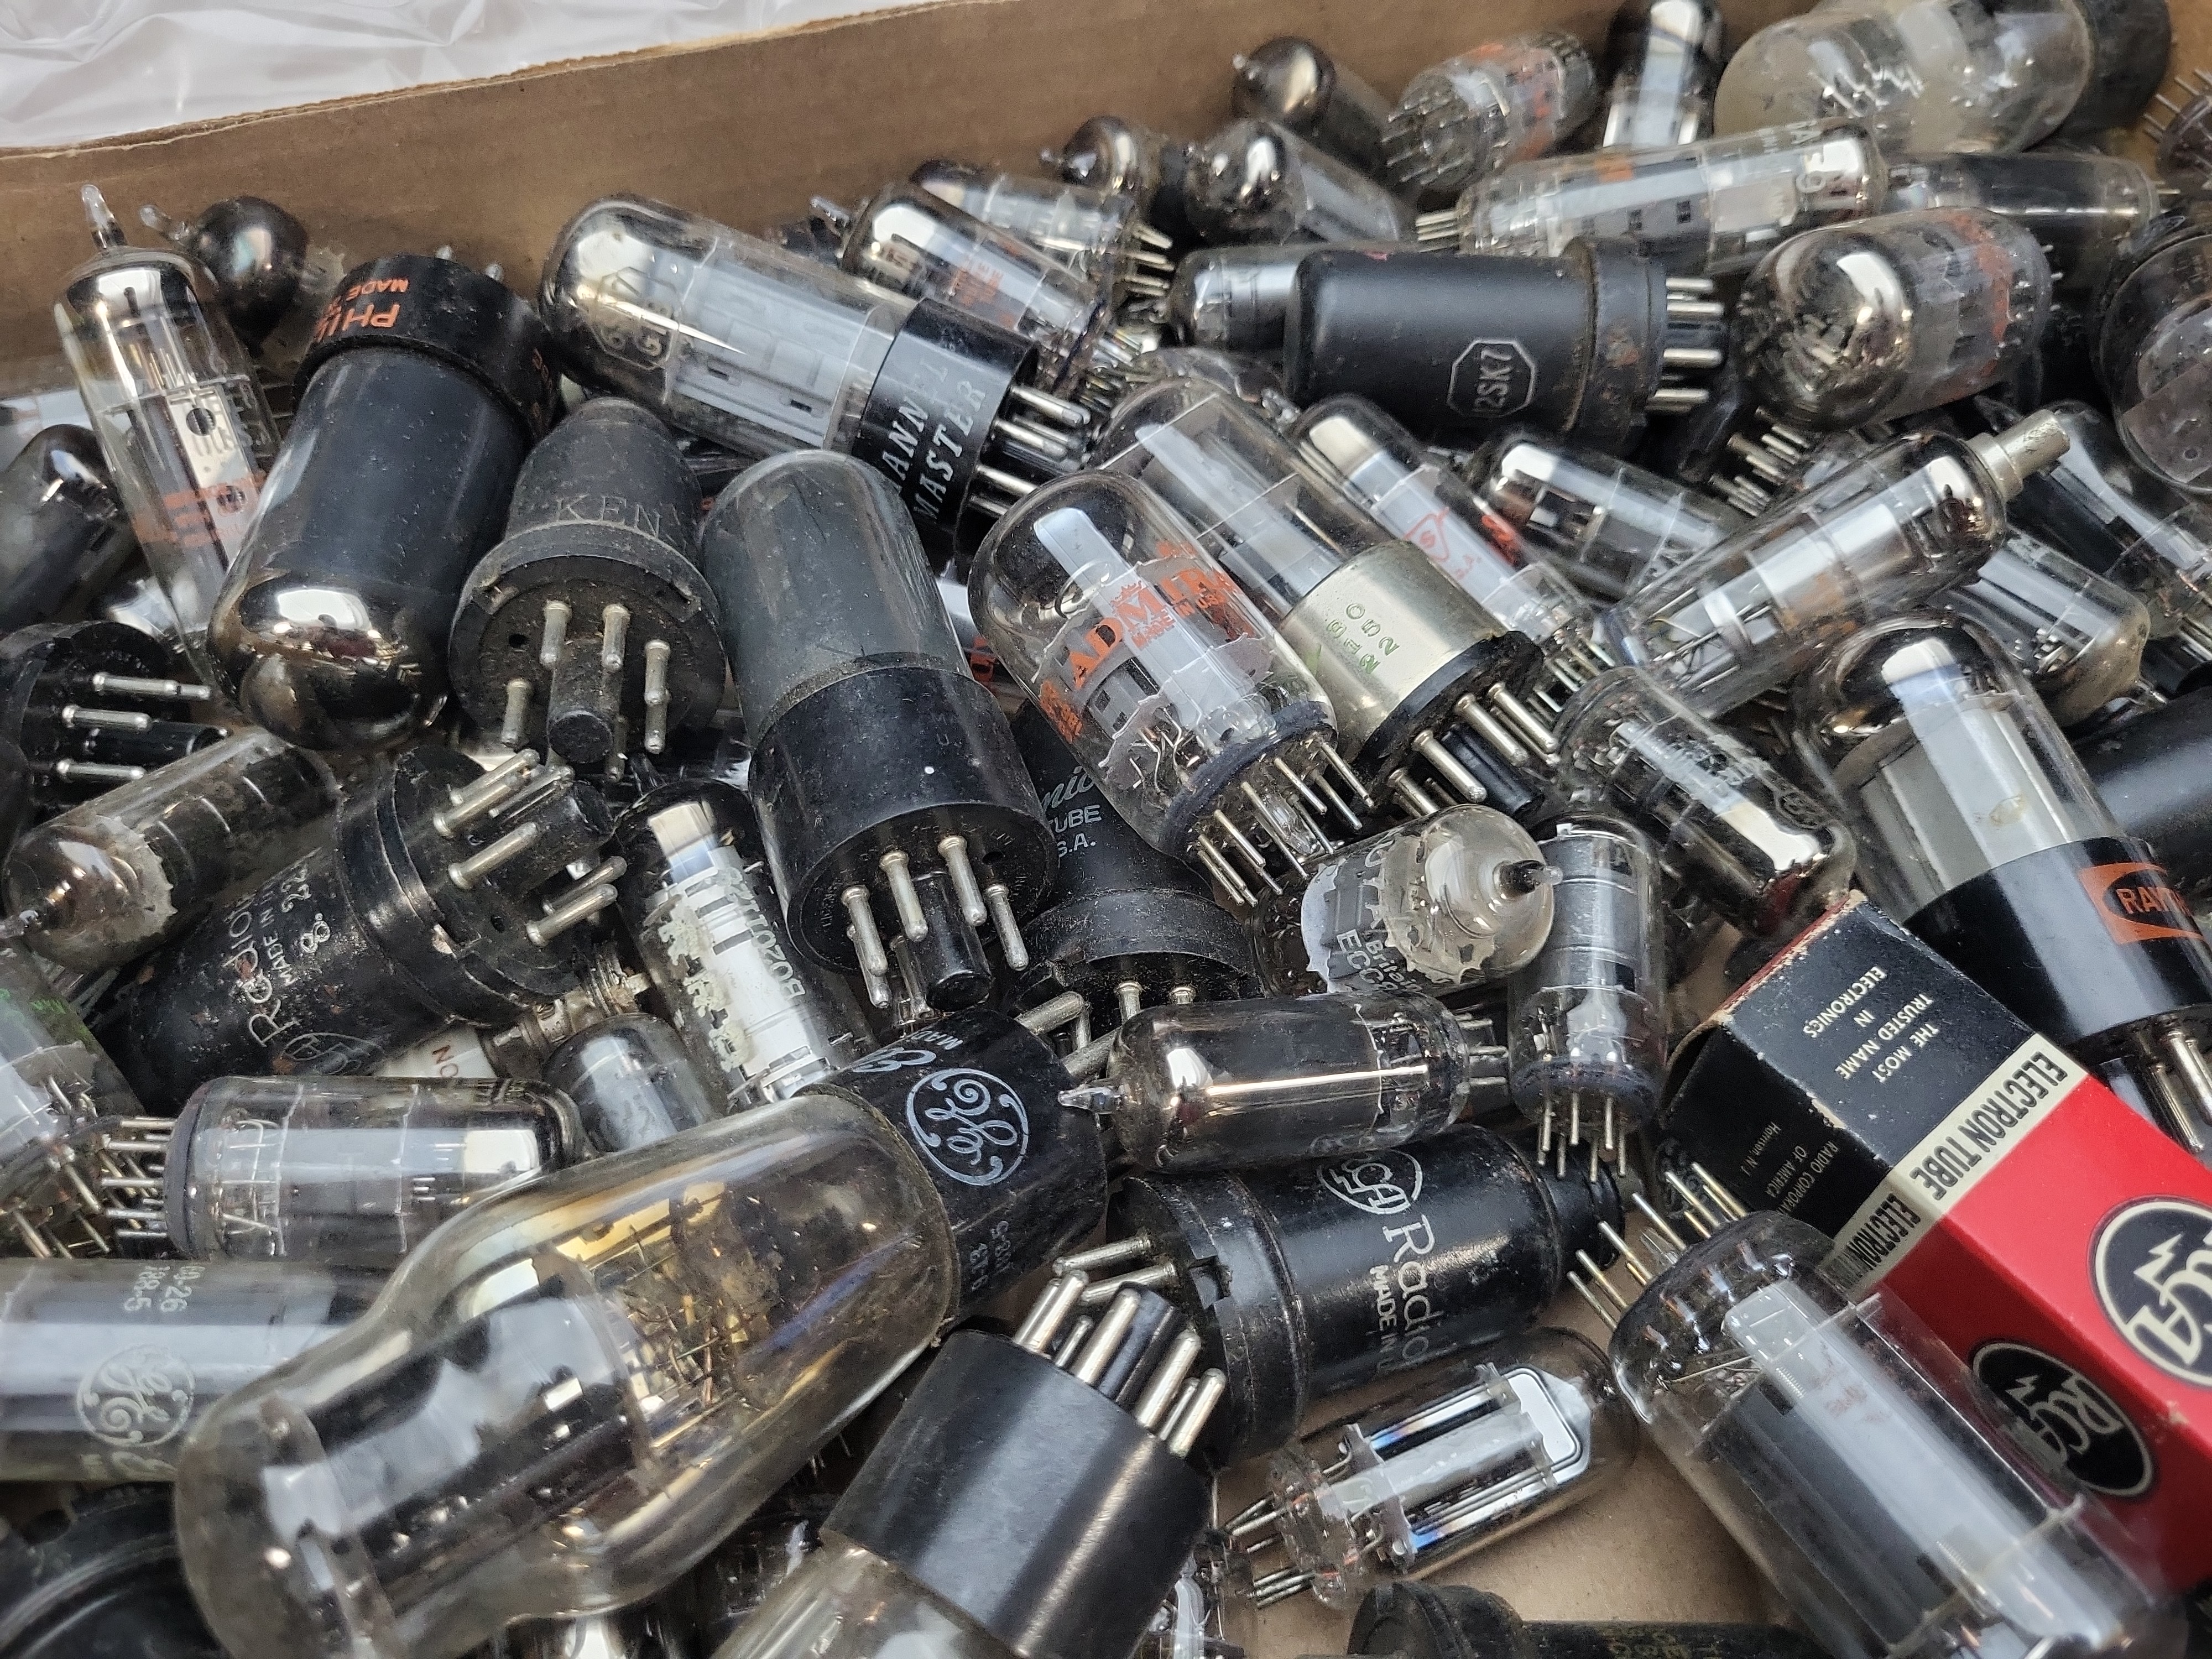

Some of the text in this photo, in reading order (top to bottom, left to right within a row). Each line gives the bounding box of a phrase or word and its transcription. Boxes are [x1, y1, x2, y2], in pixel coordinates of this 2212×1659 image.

[347, 279, 409, 300] MADE
[880, 359, 949, 492] ANNEL
[912, 380, 986, 519] MASTER
[1050, 804, 1102, 833] UBE
[264, 930, 295, 986] MADE
[1803, 967, 1887, 1037] ELECTRONICS
[1854, 1011, 1875, 1027] IN
[1834, 994, 1934, 1080] TRUSTED NAME
[1872, 1024, 1938, 1083] THE MOST
[1909, 1051, 2067, 1200] ELECTRON TUBE
[1765, 1145, 1808, 1199] OF AMERICA
[1806, 1140, 1839, 1173] RADIO
[1848, 1193, 1921, 1271] ELECTRON
[1370, 1265, 1397, 1329] MADE
